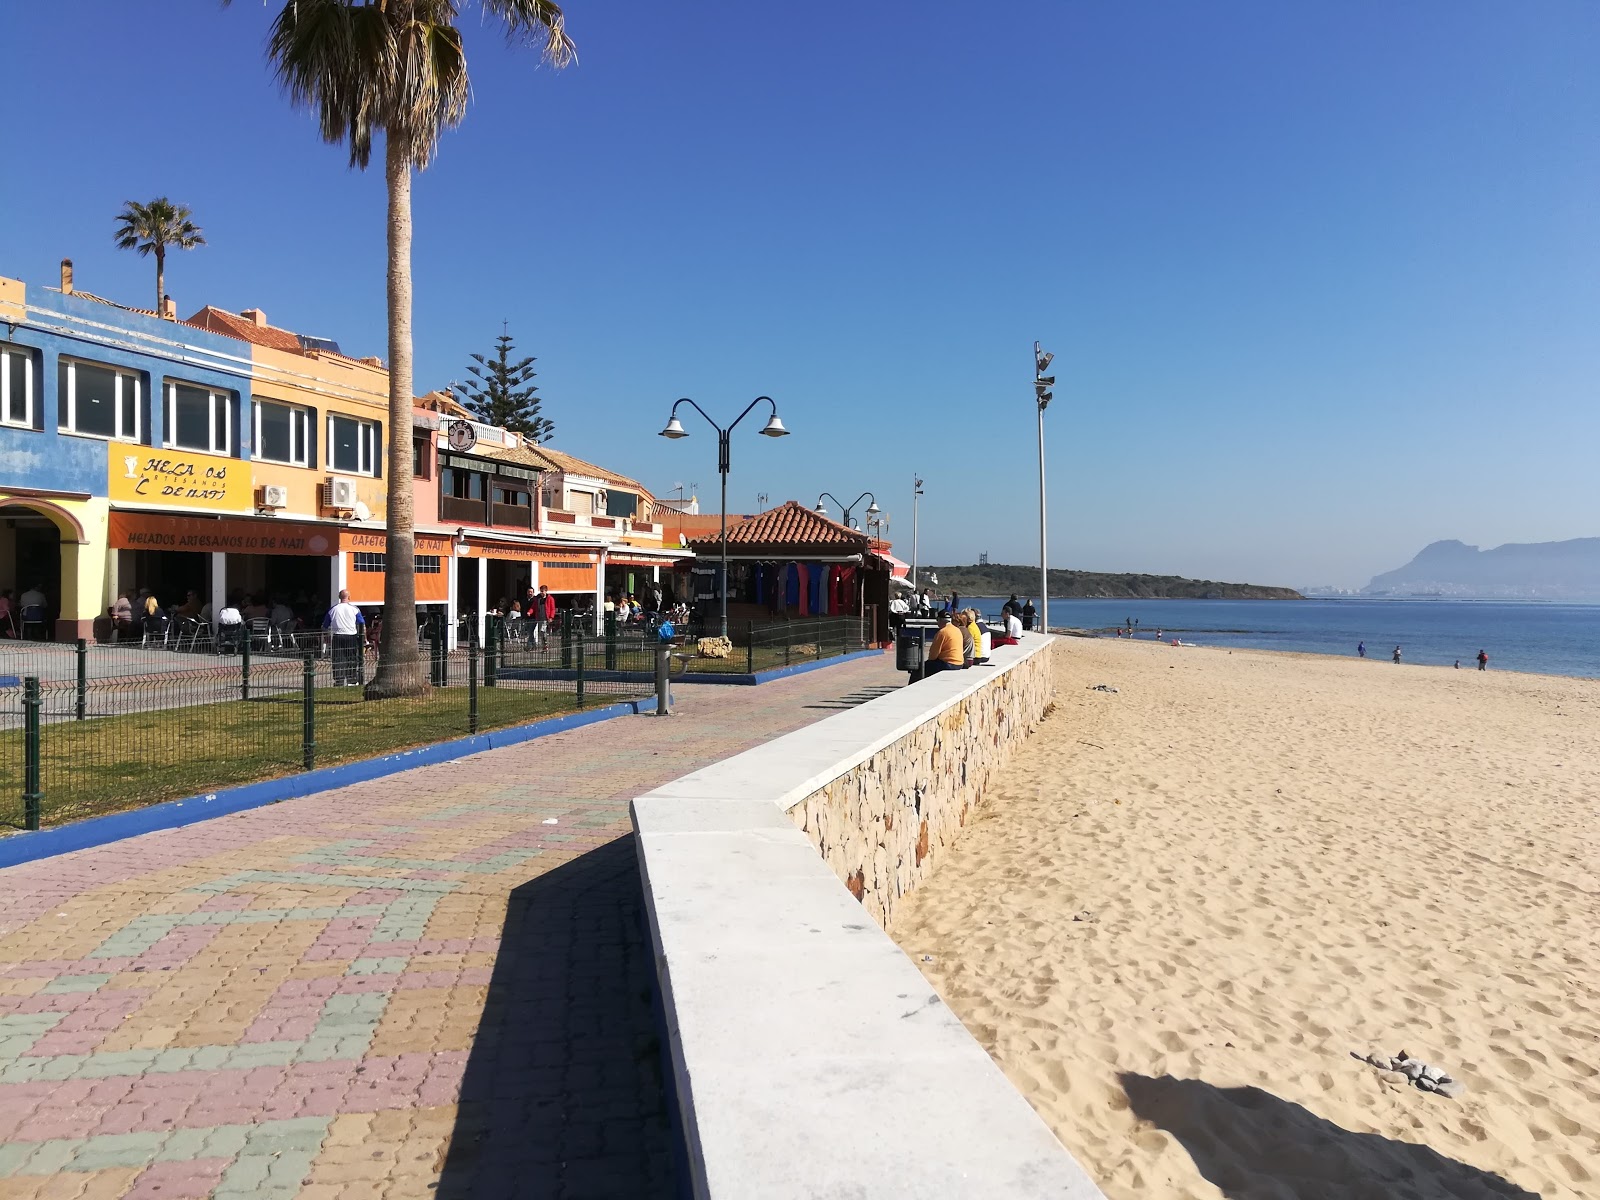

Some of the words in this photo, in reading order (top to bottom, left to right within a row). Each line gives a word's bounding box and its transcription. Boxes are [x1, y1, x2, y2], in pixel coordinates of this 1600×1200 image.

[143, 458, 227, 479] HELAOS
[140, 473, 226, 488] ARTESANOS
[161, 485, 184, 496] DE
[128, 532, 175, 546] HELADOS
[179, 535, 243, 547] ARTESANOS
[245, 537, 257, 548] LO
[261, 537, 276, 549] DE
[279, 537, 305, 550] NATI
[352, 535, 386, 548] CAFETE
[427, 540, 444, 552] NATI
